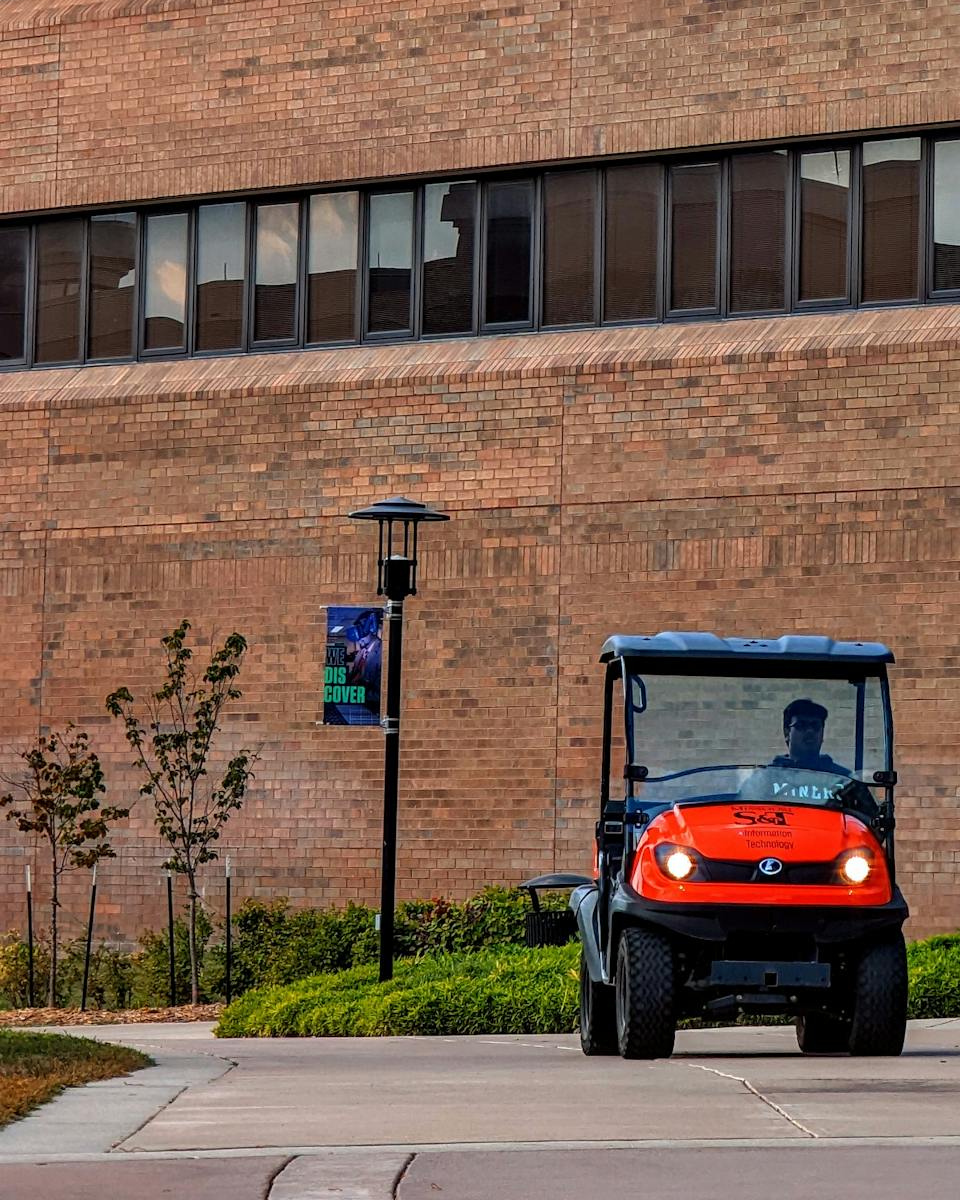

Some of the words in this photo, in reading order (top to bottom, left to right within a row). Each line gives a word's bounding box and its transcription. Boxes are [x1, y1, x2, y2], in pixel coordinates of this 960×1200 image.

[324, 666, 347, 685] DIS
[323, 685, 366, 704] COVER
[744, 829, 792, 838] Information
[746, 839, 794, 850] Technology
